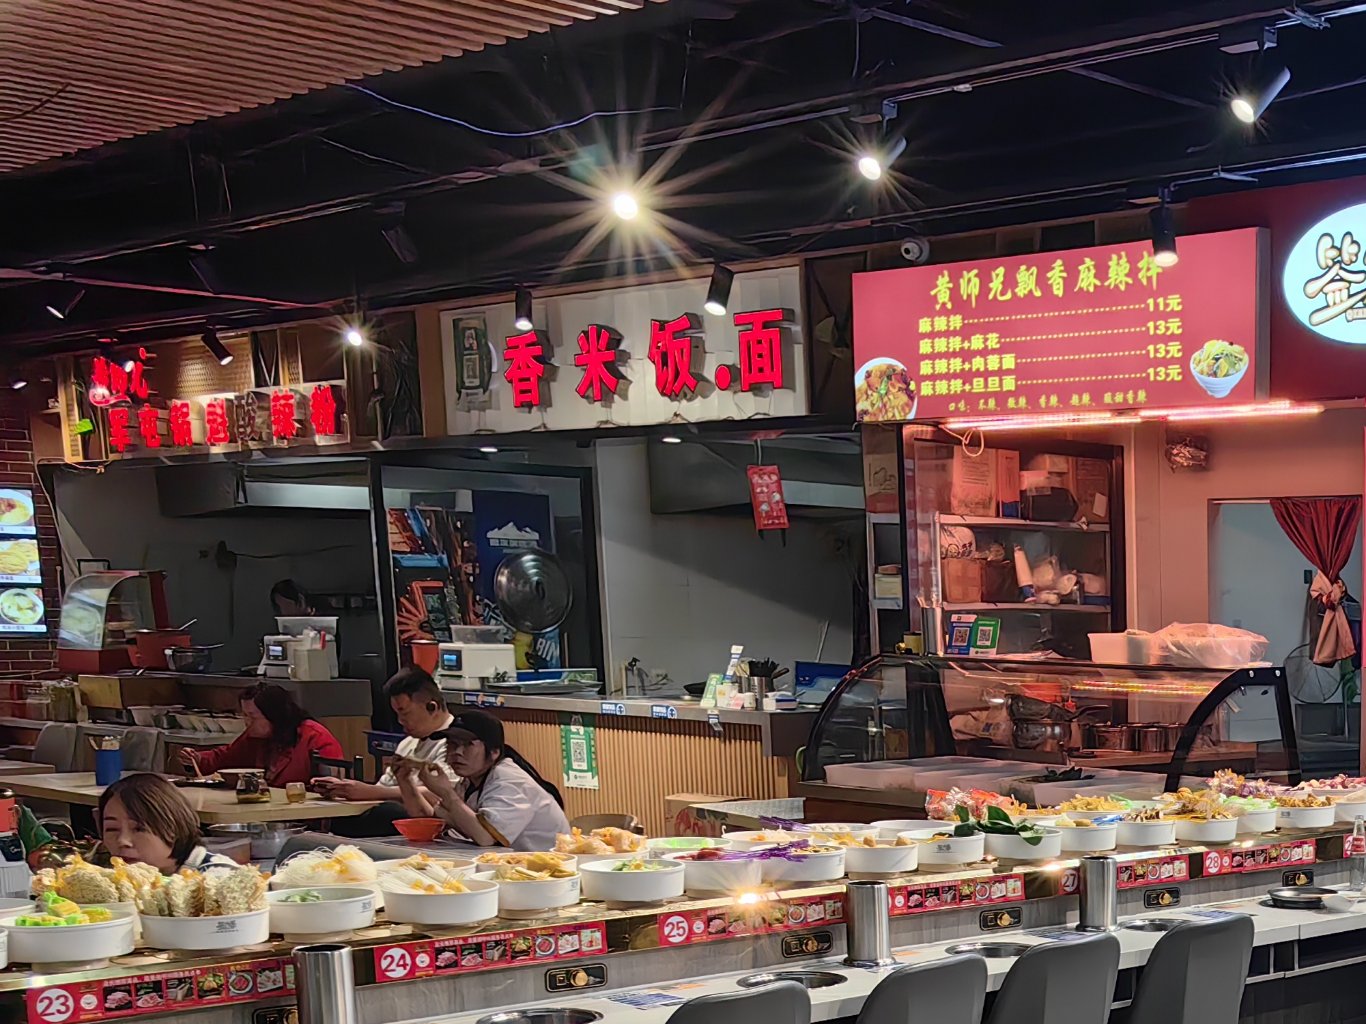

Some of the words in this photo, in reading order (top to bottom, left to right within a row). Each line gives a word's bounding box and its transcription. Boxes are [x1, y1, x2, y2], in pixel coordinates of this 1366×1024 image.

[930, 251, 1163, 311] 黄师兄飘香麻辣拌
[918, 314, 963, 333] 麻辣拌
[1146, 295, 1183, 313] 11元
[919, 332, 1000, 354] 麻辣拌+麻花
[1147, 318, 1183, 335] 13元
[1147, 341, 1183, 359] 13元
[1147, 365, 1183, 382] 13元
[1207, 856, 1221, 870] 28
[1063, 873, 1077, 886] 27
[665, 919, 688, 937] 25
[383, 954, 409, 973] 24
[38, 996, 71, 1016] 23
